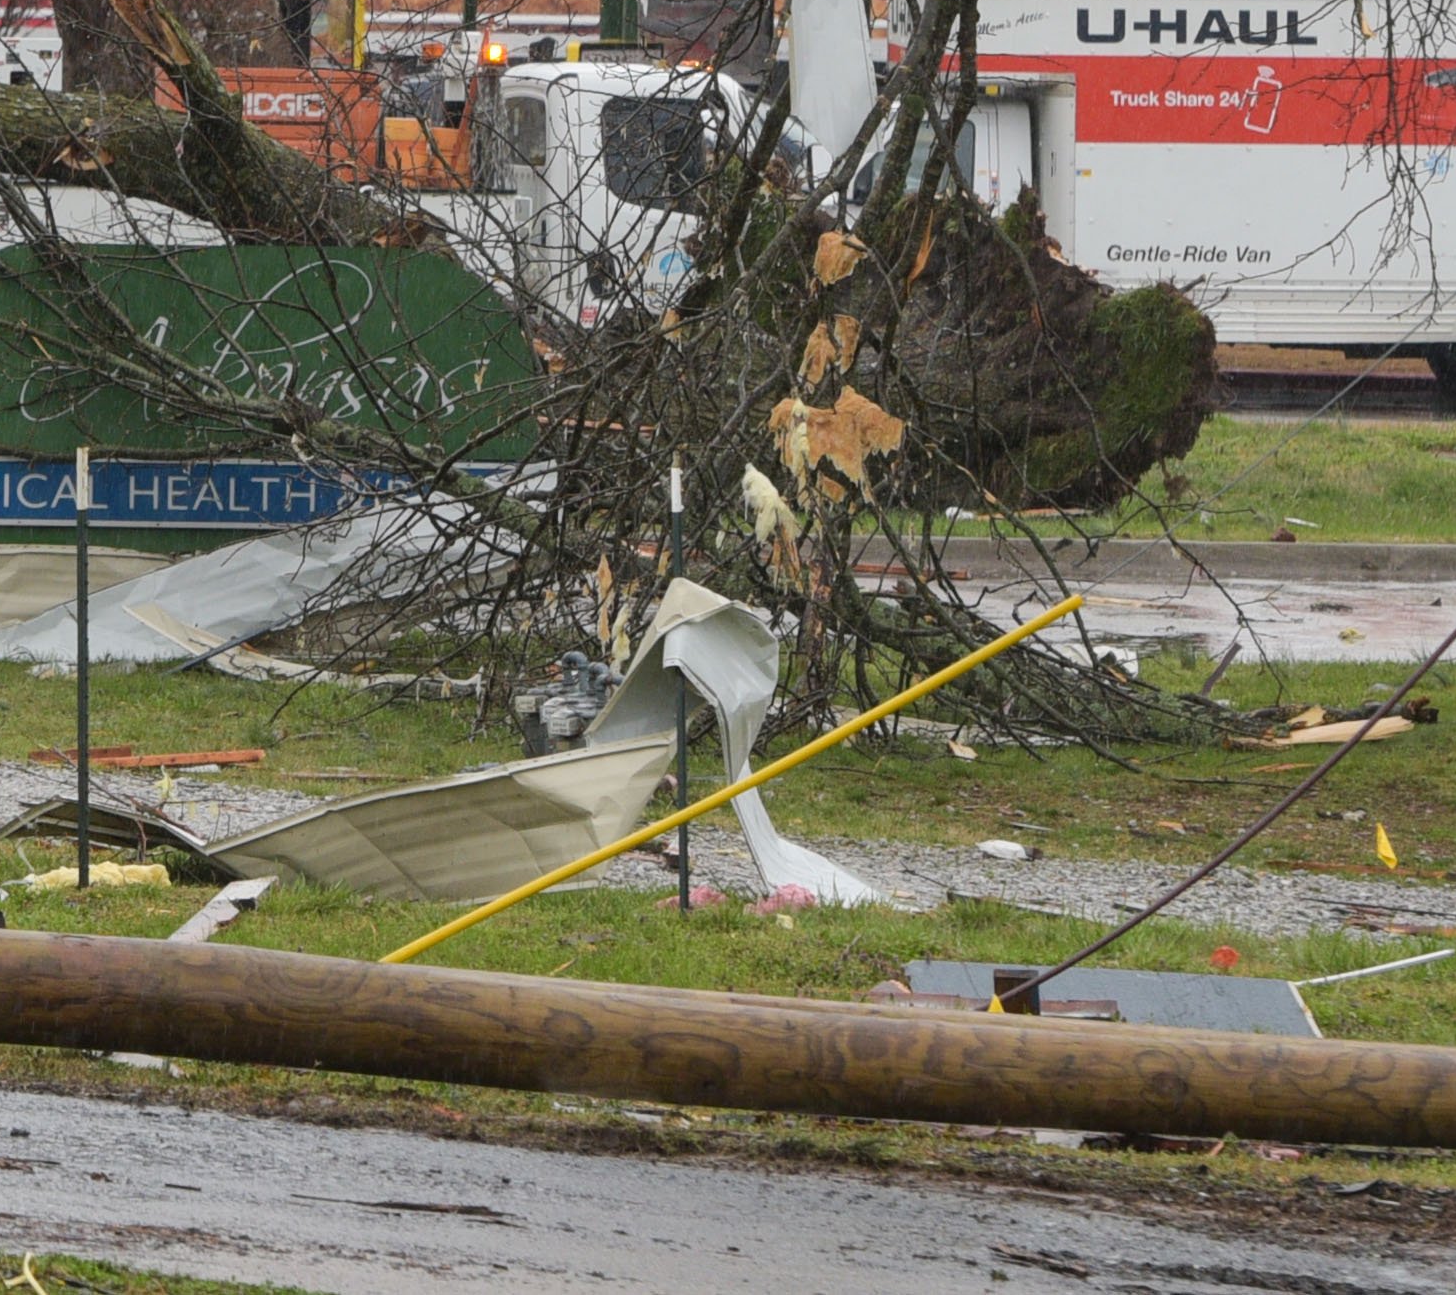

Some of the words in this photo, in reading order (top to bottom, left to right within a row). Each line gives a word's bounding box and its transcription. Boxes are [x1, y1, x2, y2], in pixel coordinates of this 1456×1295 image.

[1077, 8, 1318, 47] U-HAUL
[1110, 90, 1159, 107] Truck
[1165, 90, 1214, 107] Share
[1106, 244, 1228, 263] Gentle-Ride
[1235, 245, 1272, 263] Van
[130, 475, 316, 513] HEALTH
